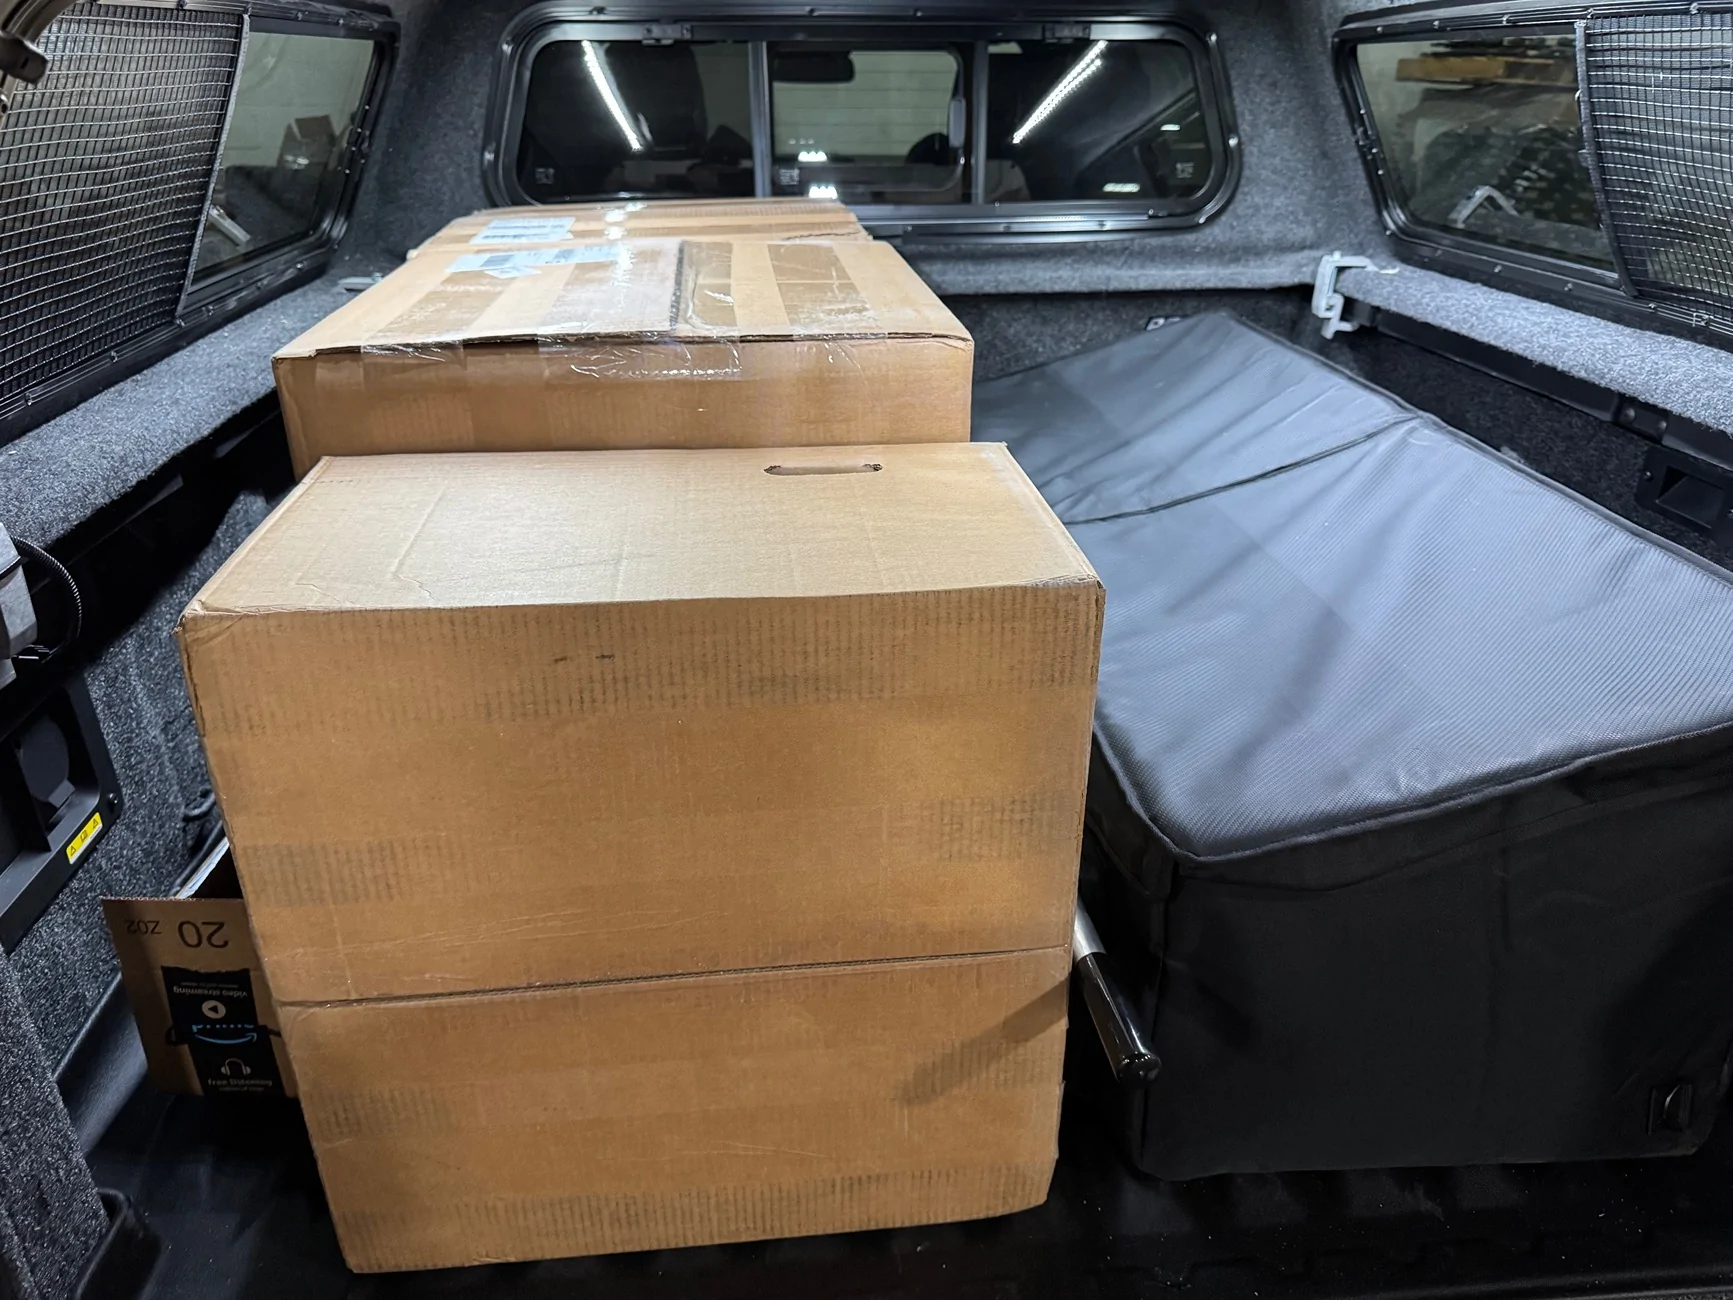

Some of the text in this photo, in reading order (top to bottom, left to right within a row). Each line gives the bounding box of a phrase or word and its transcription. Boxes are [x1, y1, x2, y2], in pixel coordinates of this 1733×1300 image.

[177, 920, 229, 949] 20
[173, 985, 221, 997] streaming
[222, 988, 248, 998] video
